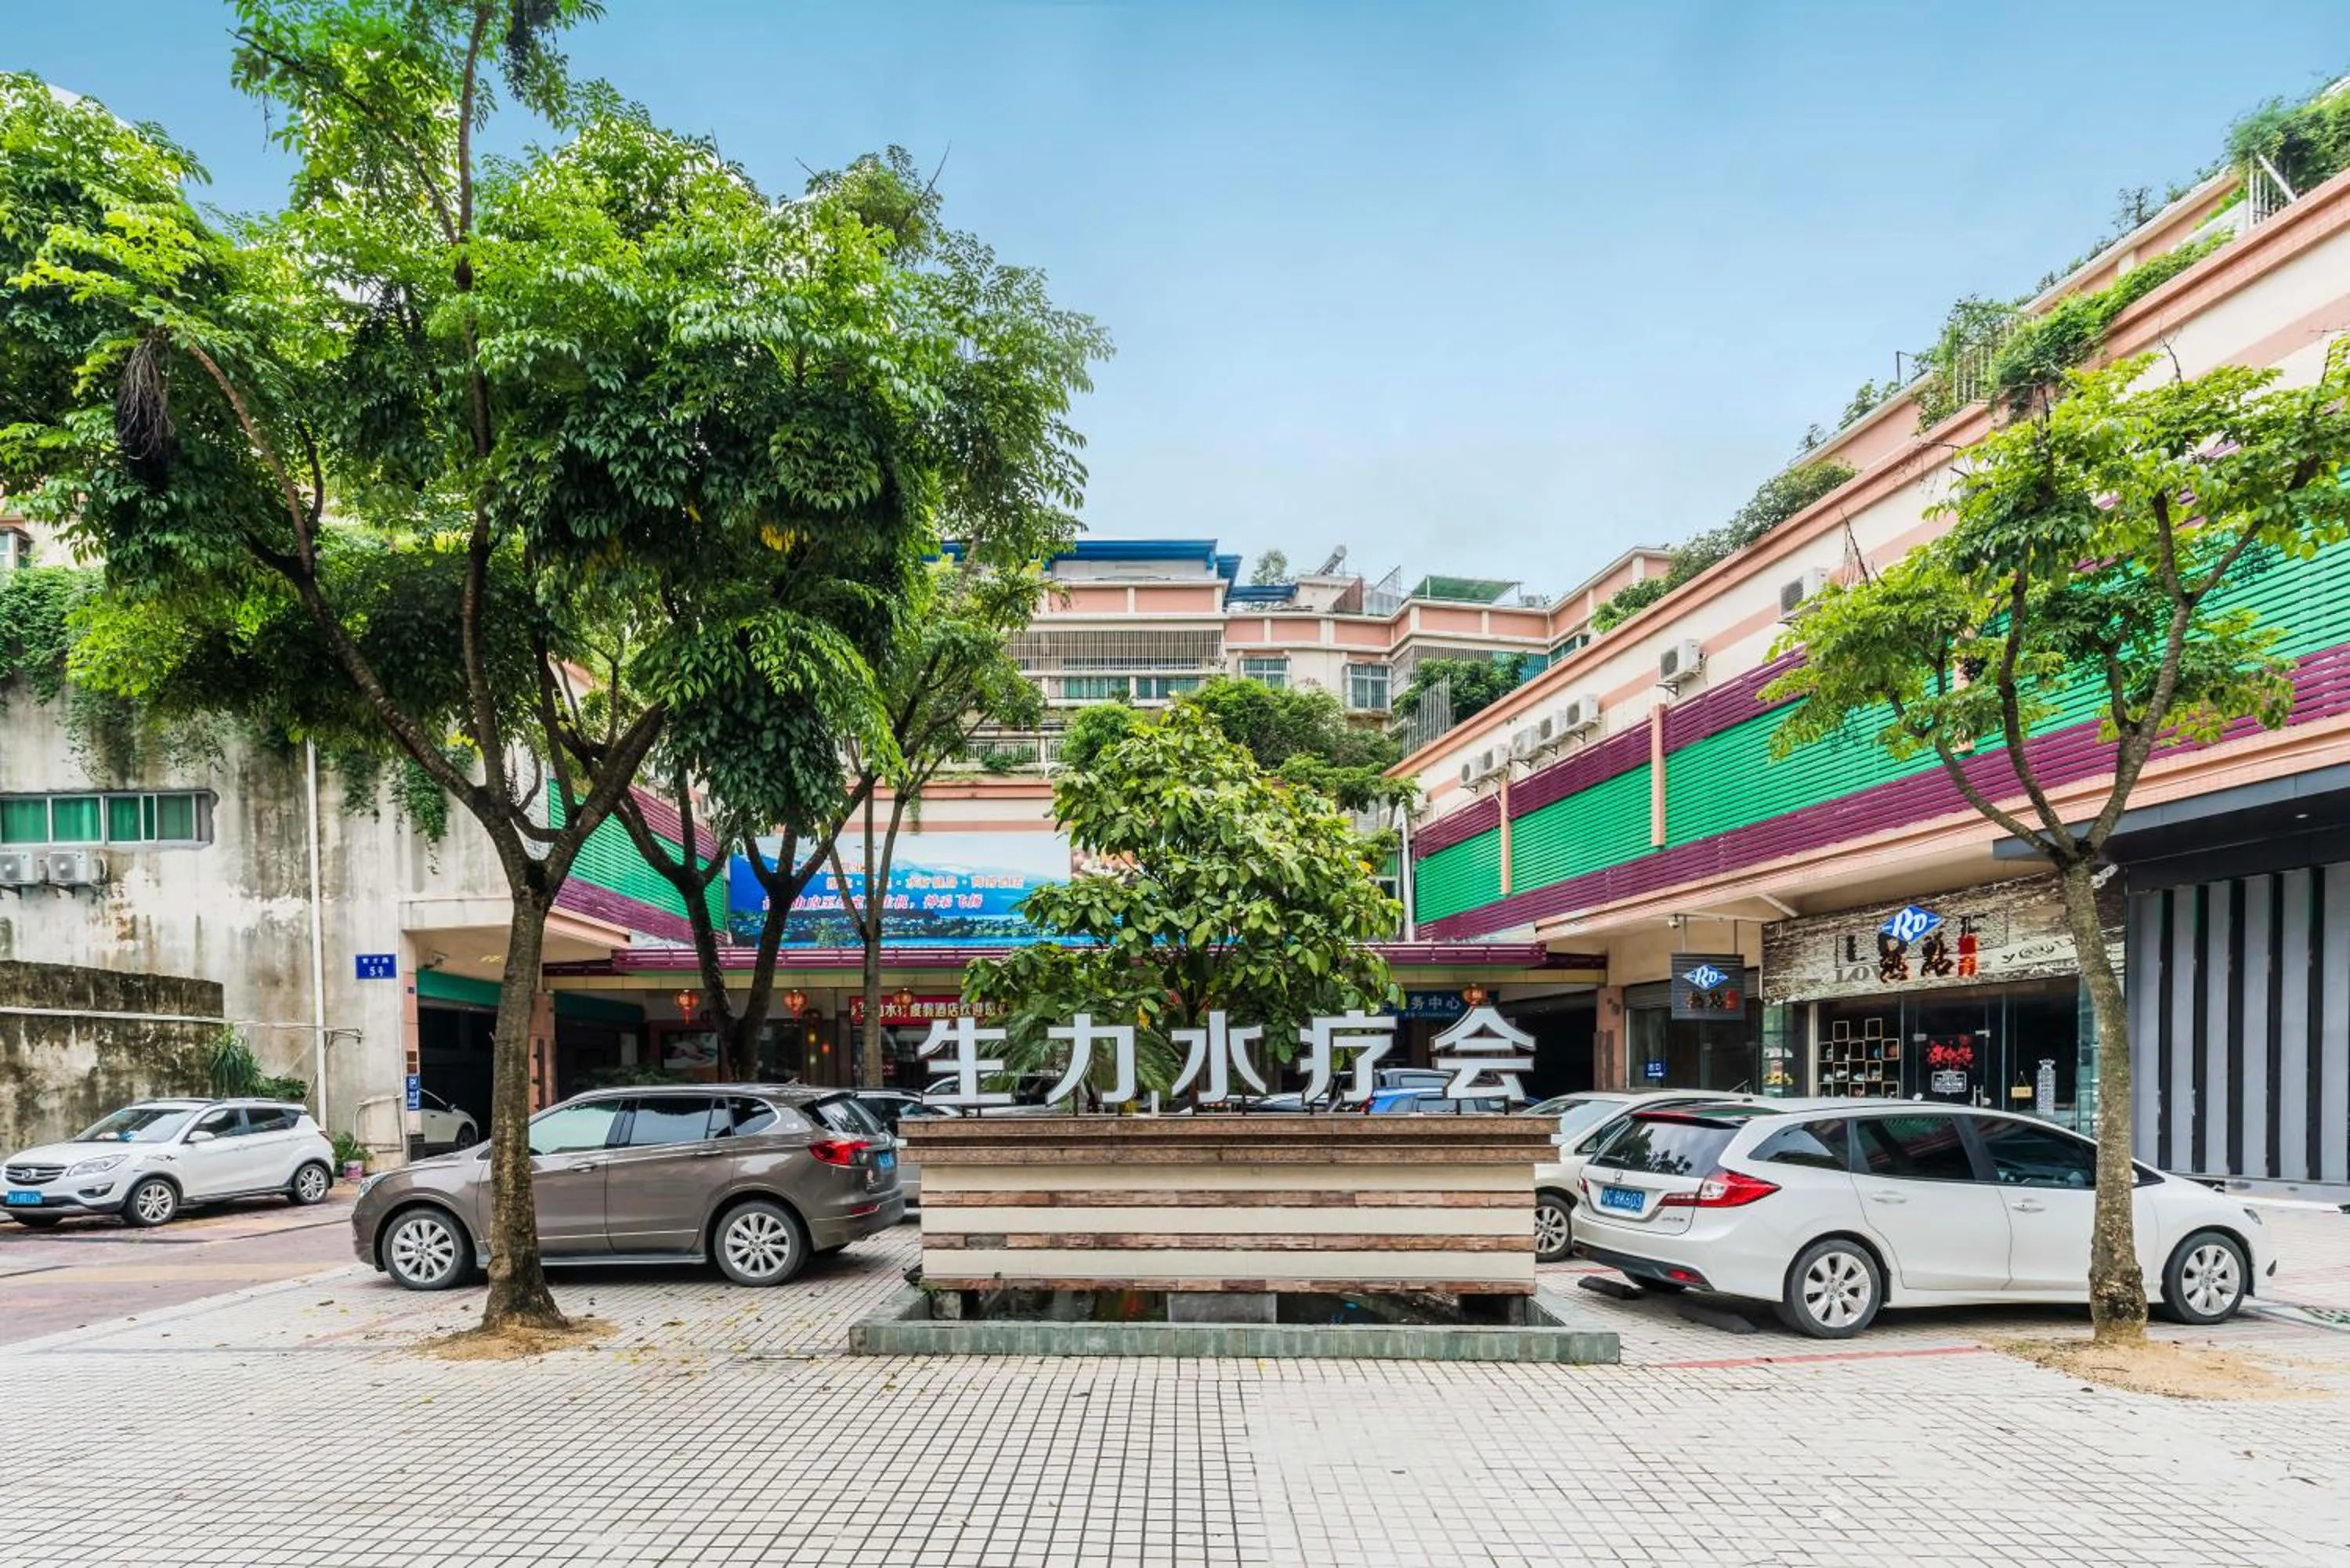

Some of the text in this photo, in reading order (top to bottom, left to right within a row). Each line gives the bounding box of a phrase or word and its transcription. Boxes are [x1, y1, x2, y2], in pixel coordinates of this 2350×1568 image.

[1893, 909, 1928, 941] RD
[1695, 965, 1718, 988] RD
[918, 1006, 1537, 1105] 生力水疗会
